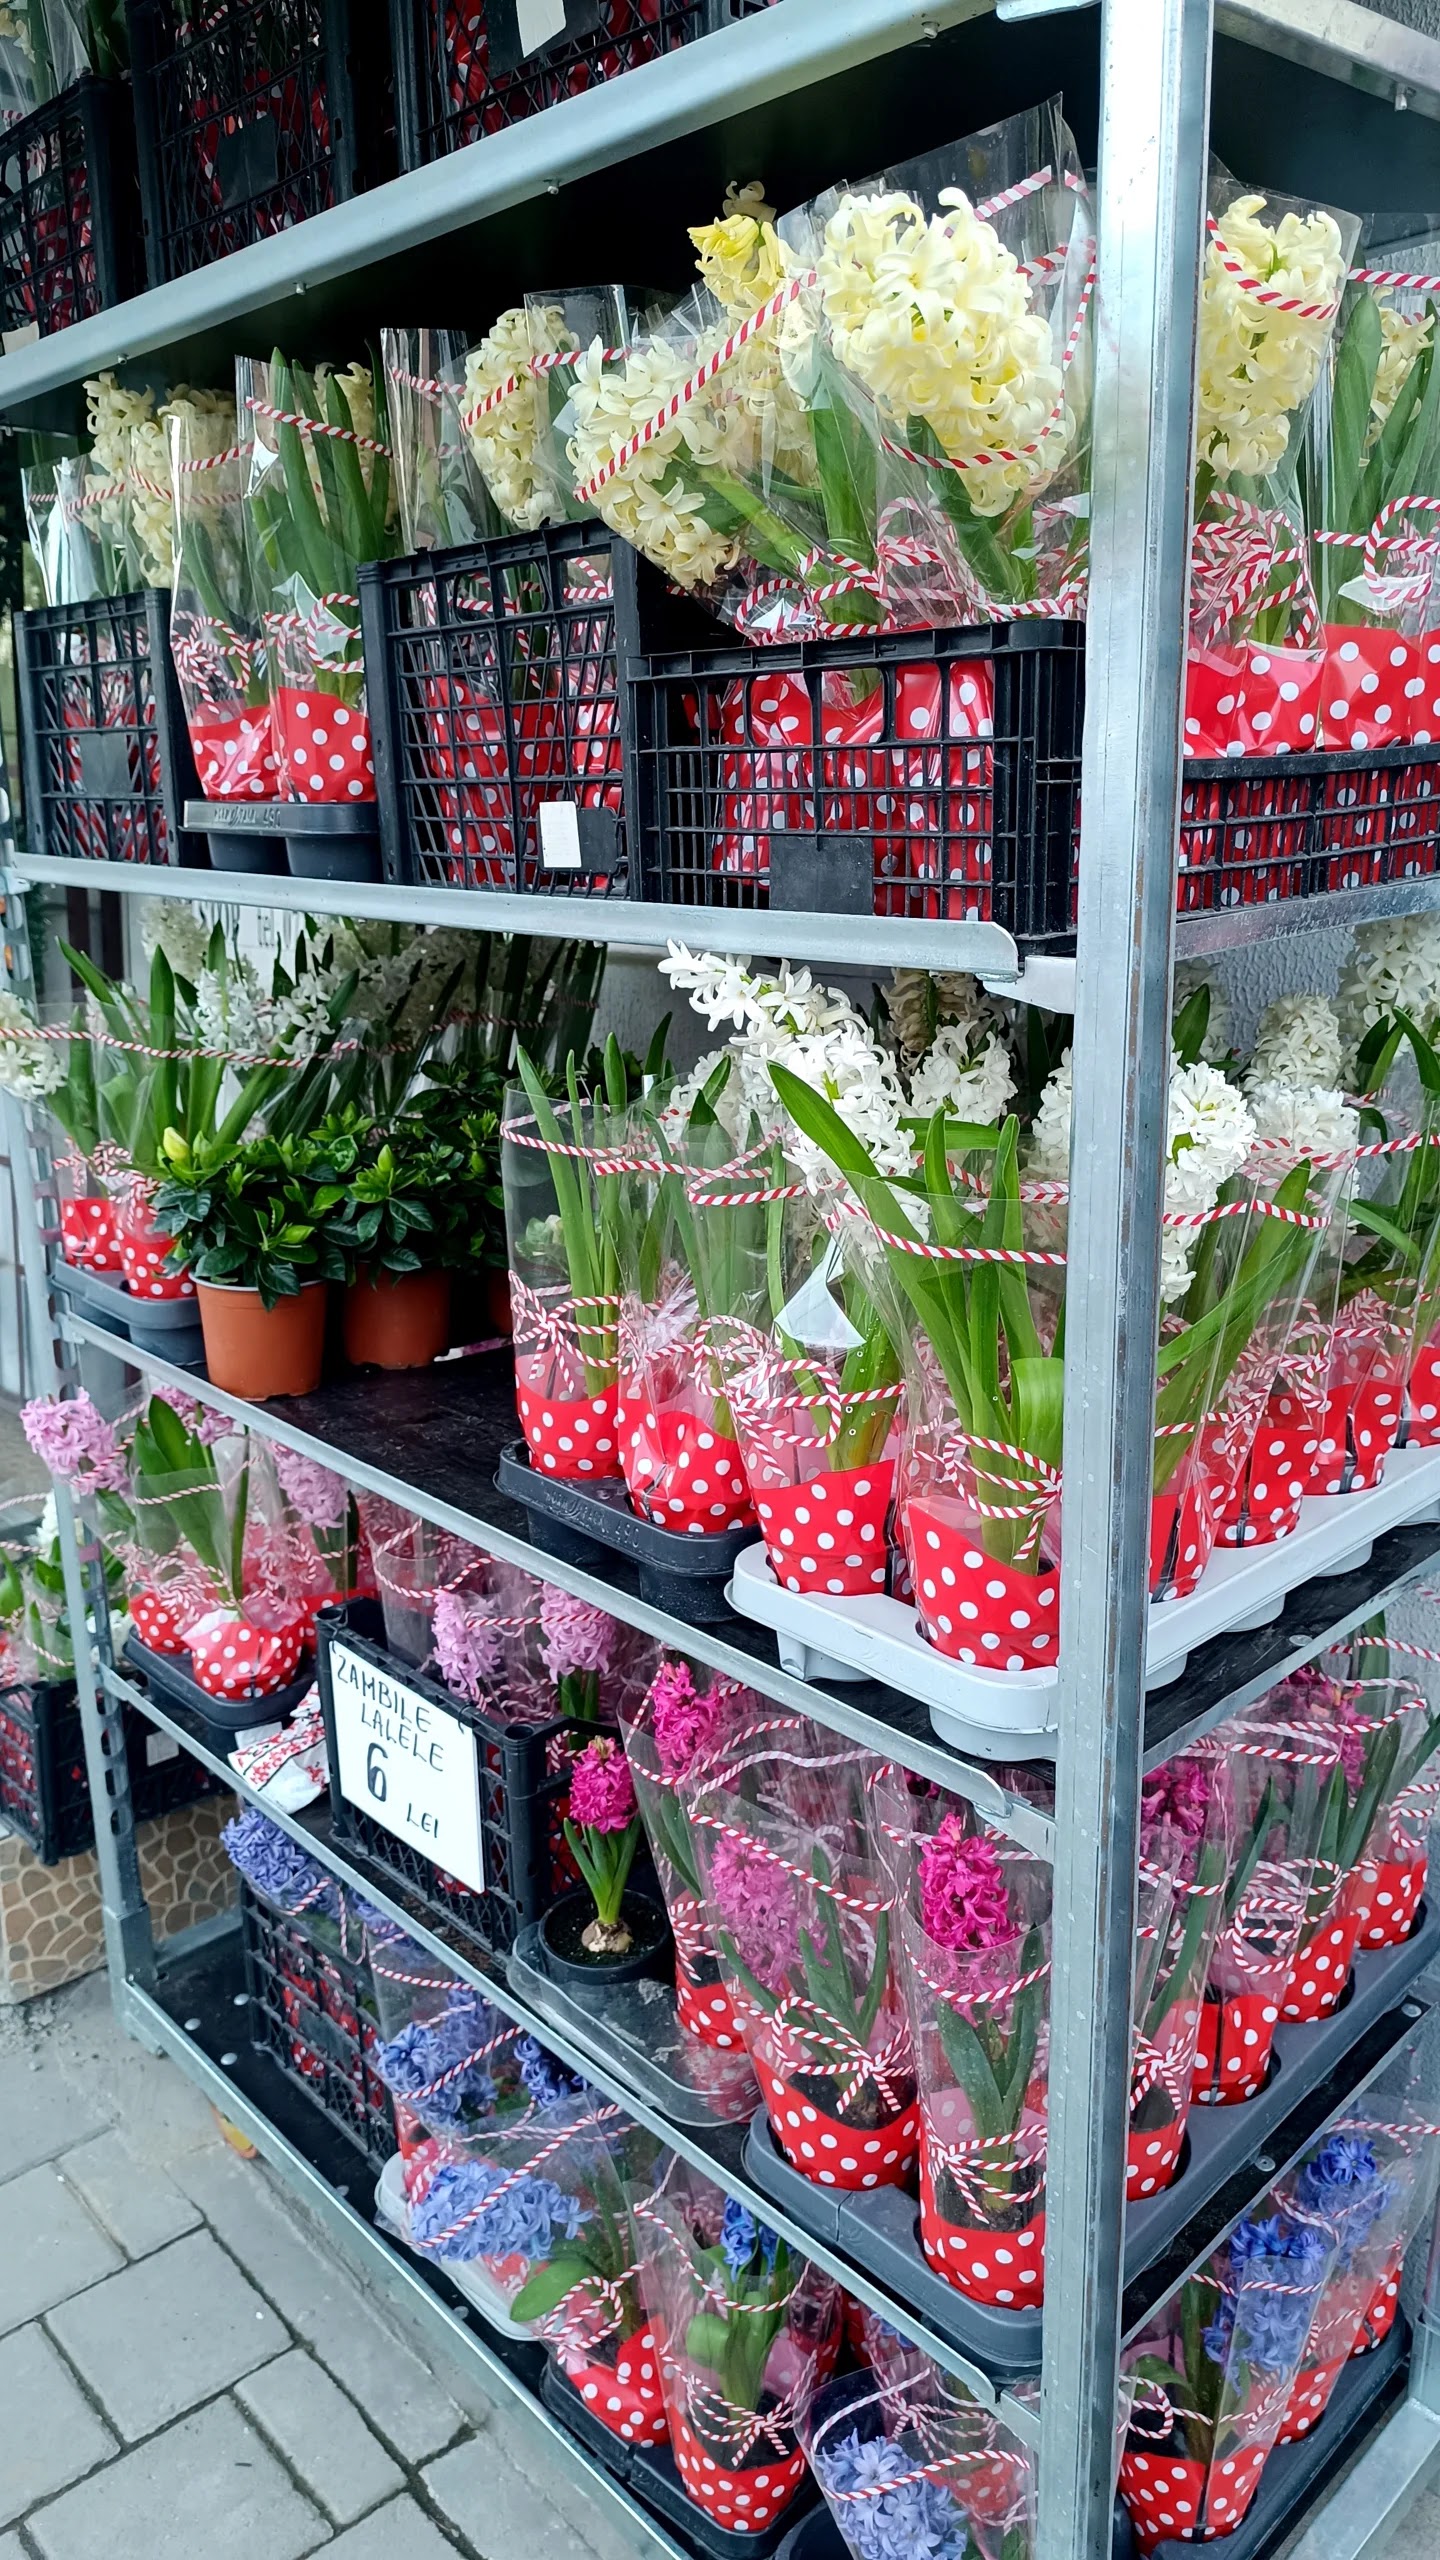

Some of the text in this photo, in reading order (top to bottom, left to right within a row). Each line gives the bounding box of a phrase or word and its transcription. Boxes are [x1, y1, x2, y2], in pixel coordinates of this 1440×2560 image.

[337, 1654, 431, 1733] ZAMBILE
[361, 1702, 444, 1772] LALELE
[367, 1742, 439, 1838] 6 LEI
